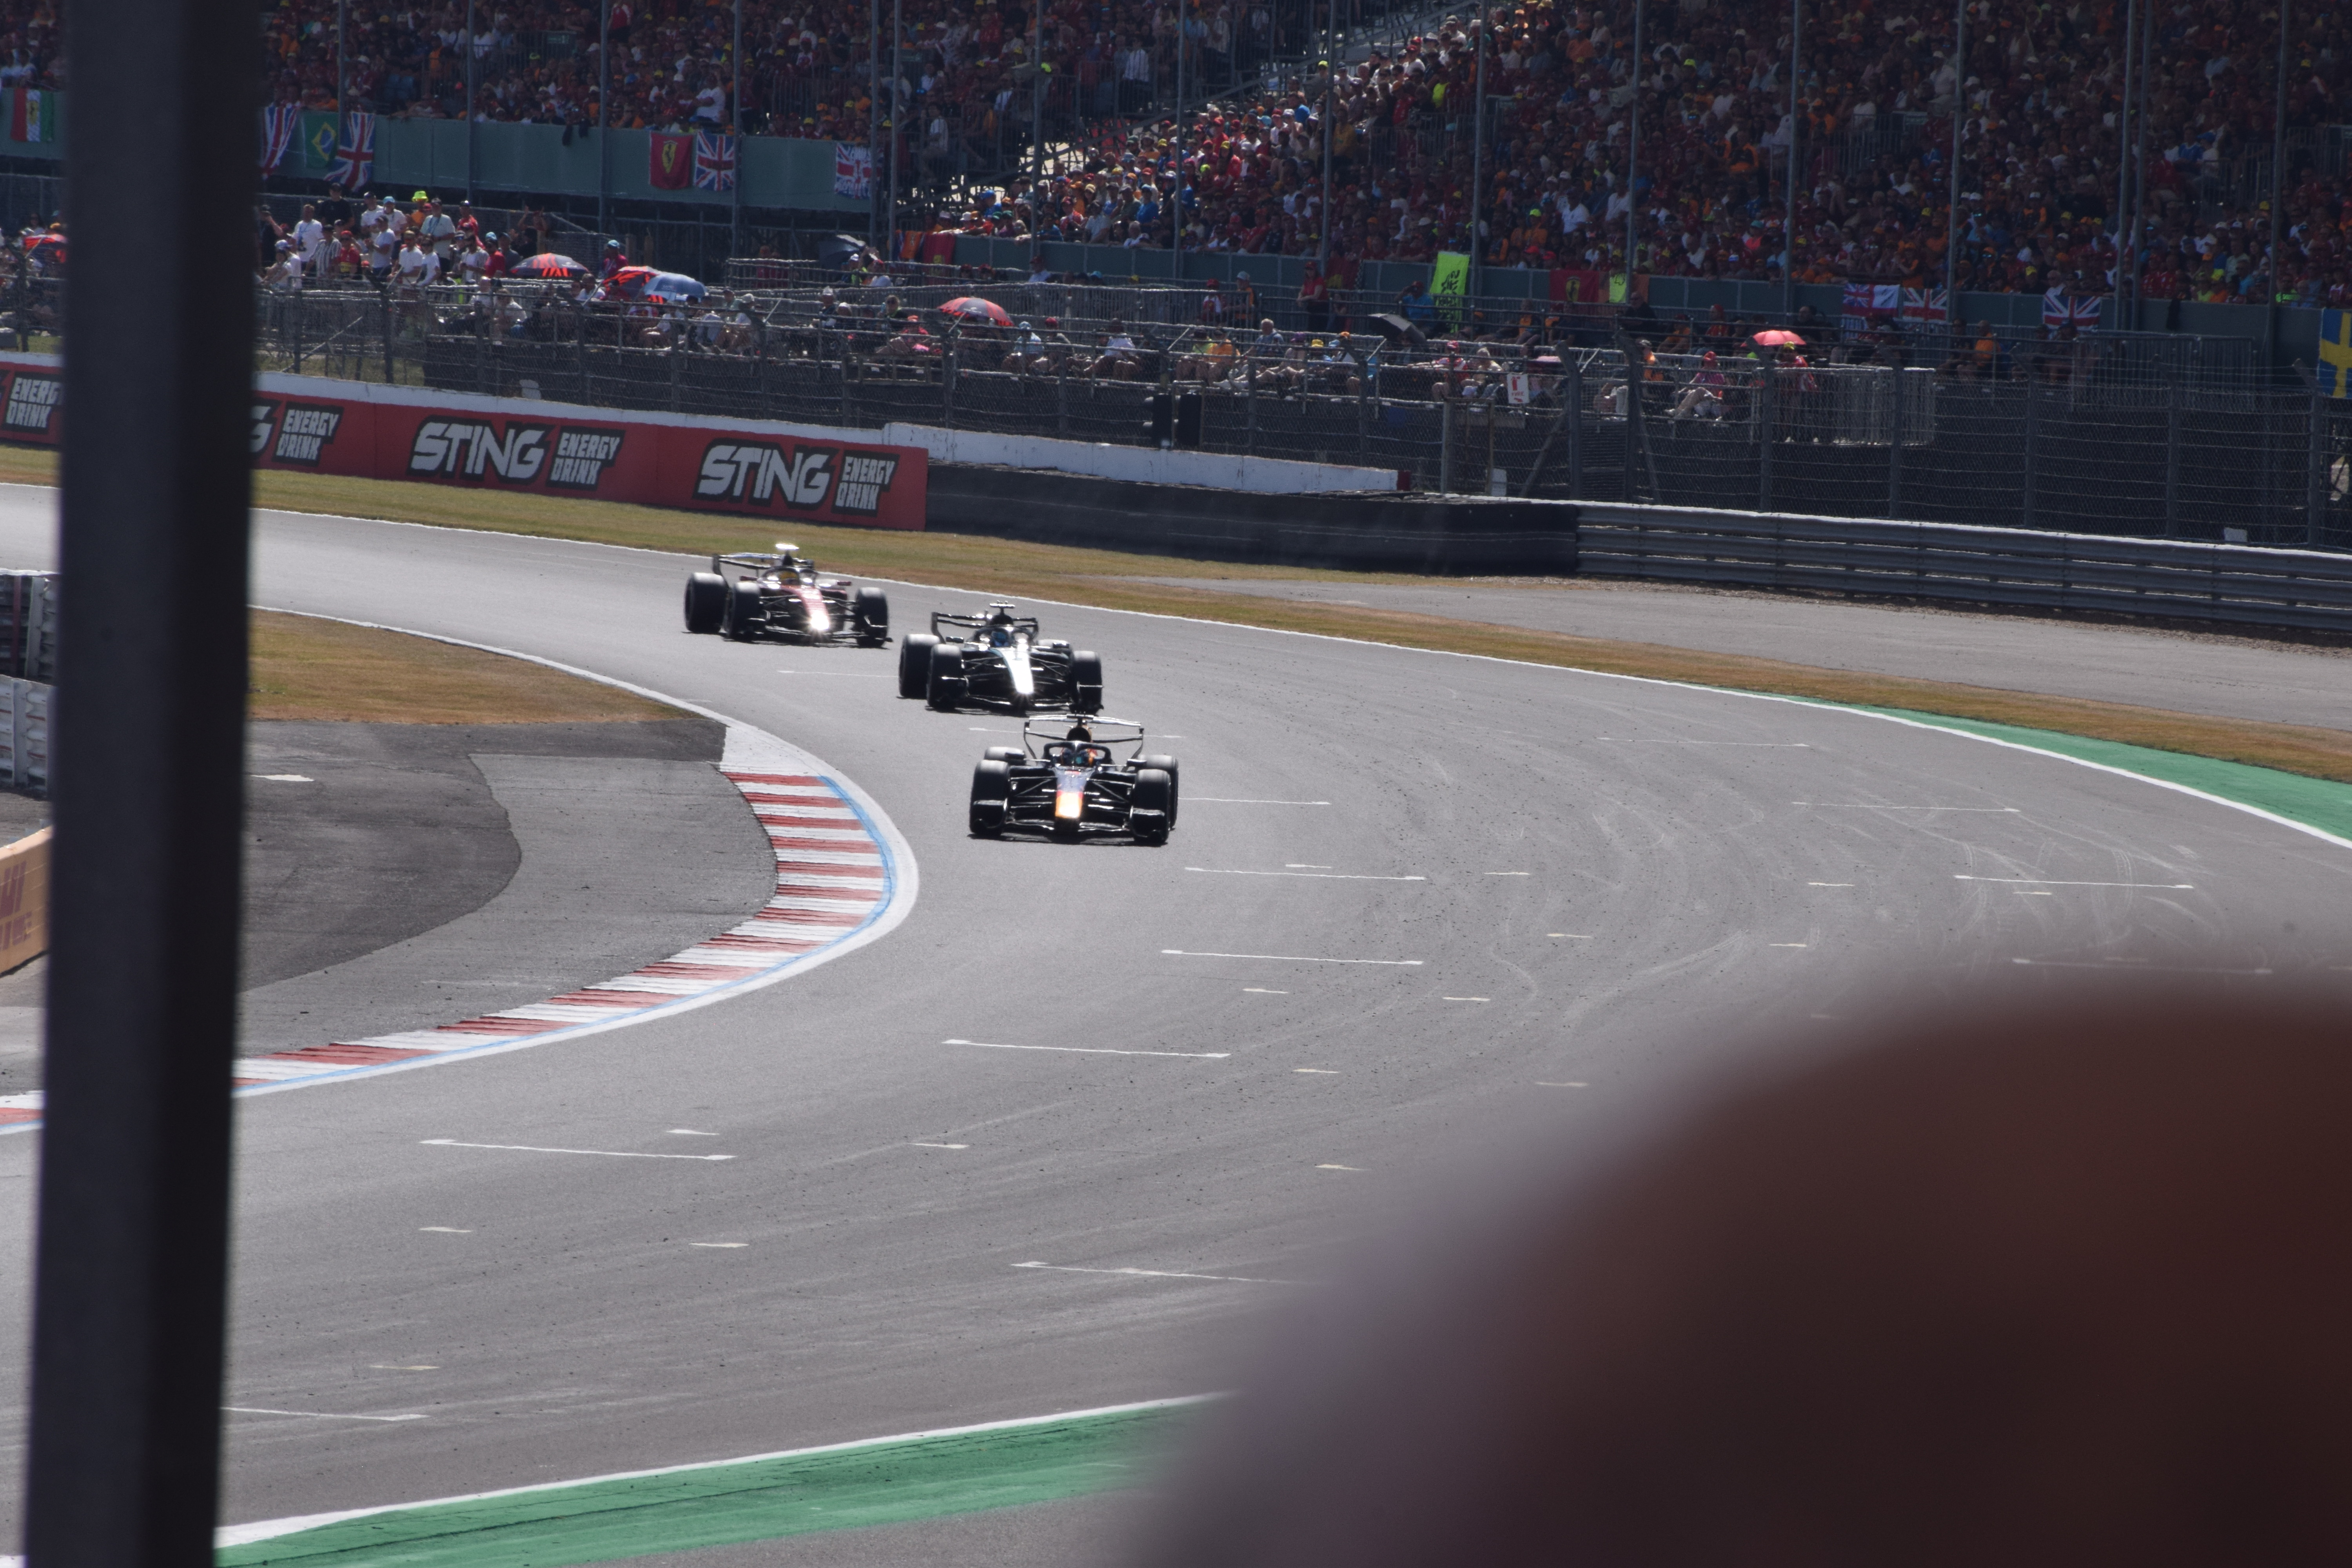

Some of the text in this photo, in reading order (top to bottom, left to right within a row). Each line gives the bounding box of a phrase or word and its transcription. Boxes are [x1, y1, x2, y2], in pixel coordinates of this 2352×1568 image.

[10, 377, 62, 405] ENERG
[6, 400, 51, 428] DRINK
[282, 409, 339, 436] ENERGY
[276, 433, 321, 460] DRINK
[411, 422, 545, 478] STING
[557, 432, 620, 459] ENERGY
[550, 457, 601, 485] DRINK
[697, 445, 829, 503] STING
[842, 456, 895, 485] ENERGY
[835, 481, 880, 510] DRINK
